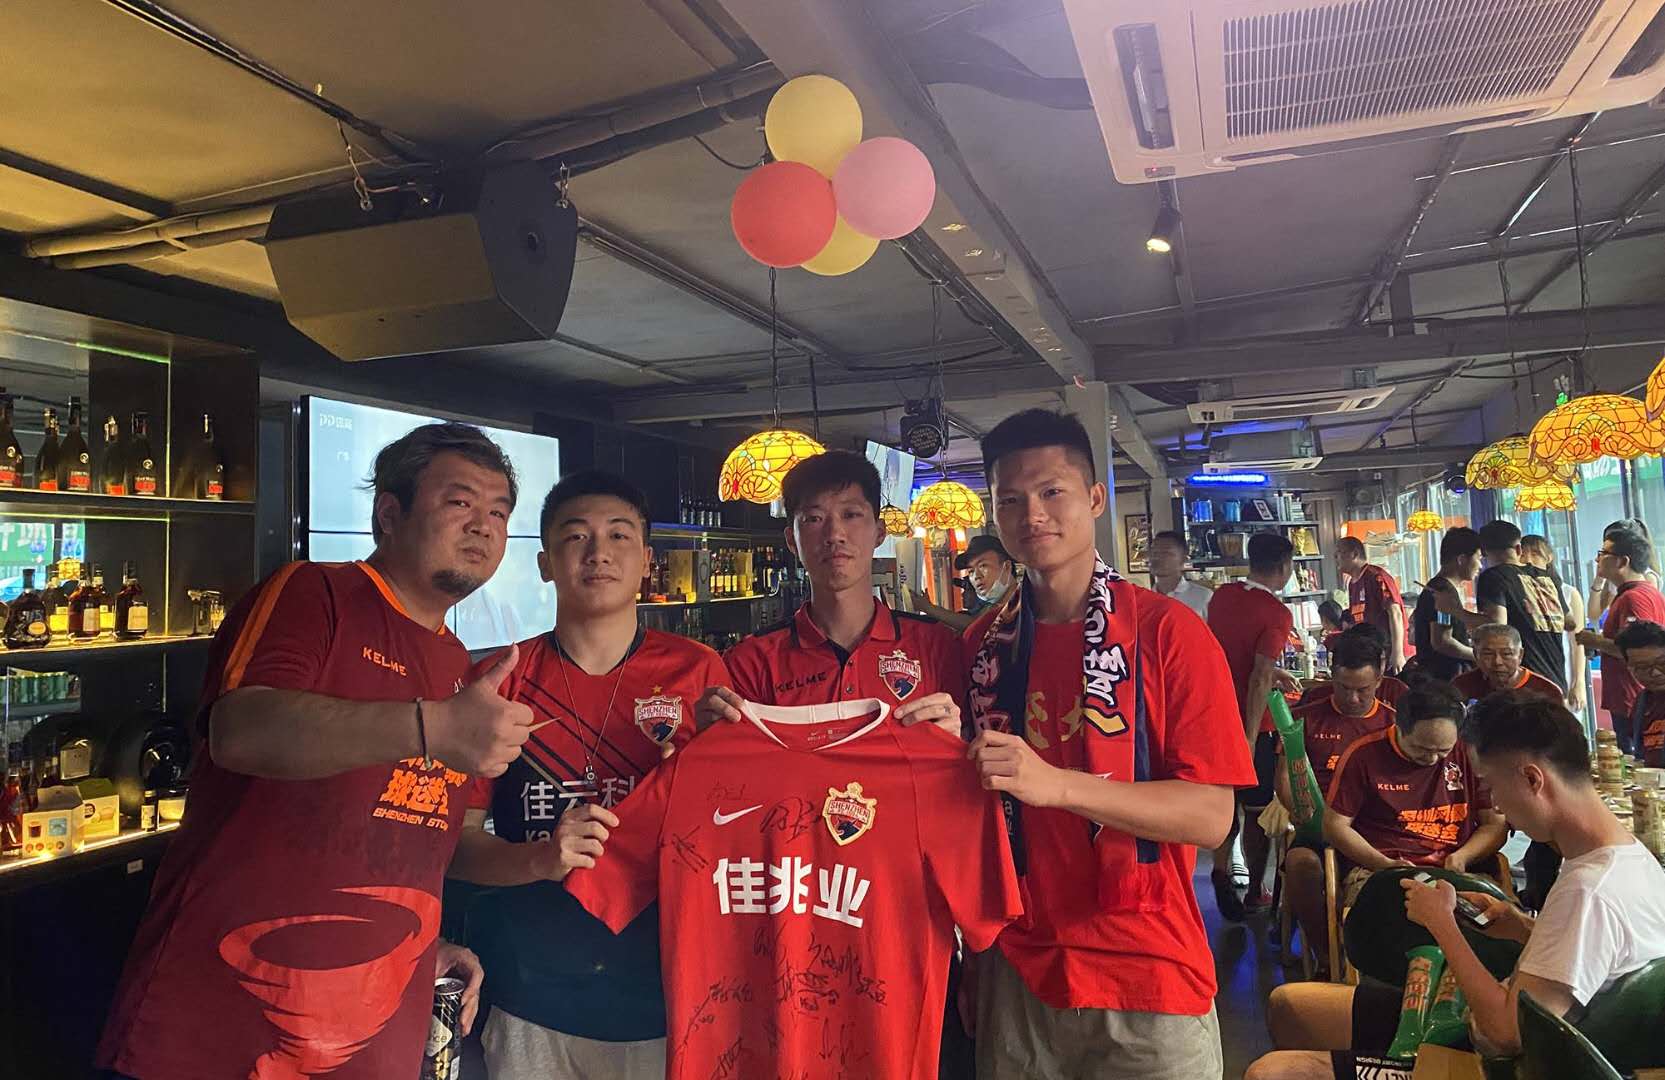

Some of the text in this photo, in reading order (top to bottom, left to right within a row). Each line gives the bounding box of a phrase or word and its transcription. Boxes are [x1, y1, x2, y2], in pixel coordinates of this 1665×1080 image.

[362, 647, 408, 677] KELME
[775, 671, 828, 693] KELME
[1377, 783, 1410, 791] KELME
[372, 807, 425, 825] SHENZHEN
[830, 800, 870, 818] SHENZHEN
[713, 856, 871, 929] 佳兆业
